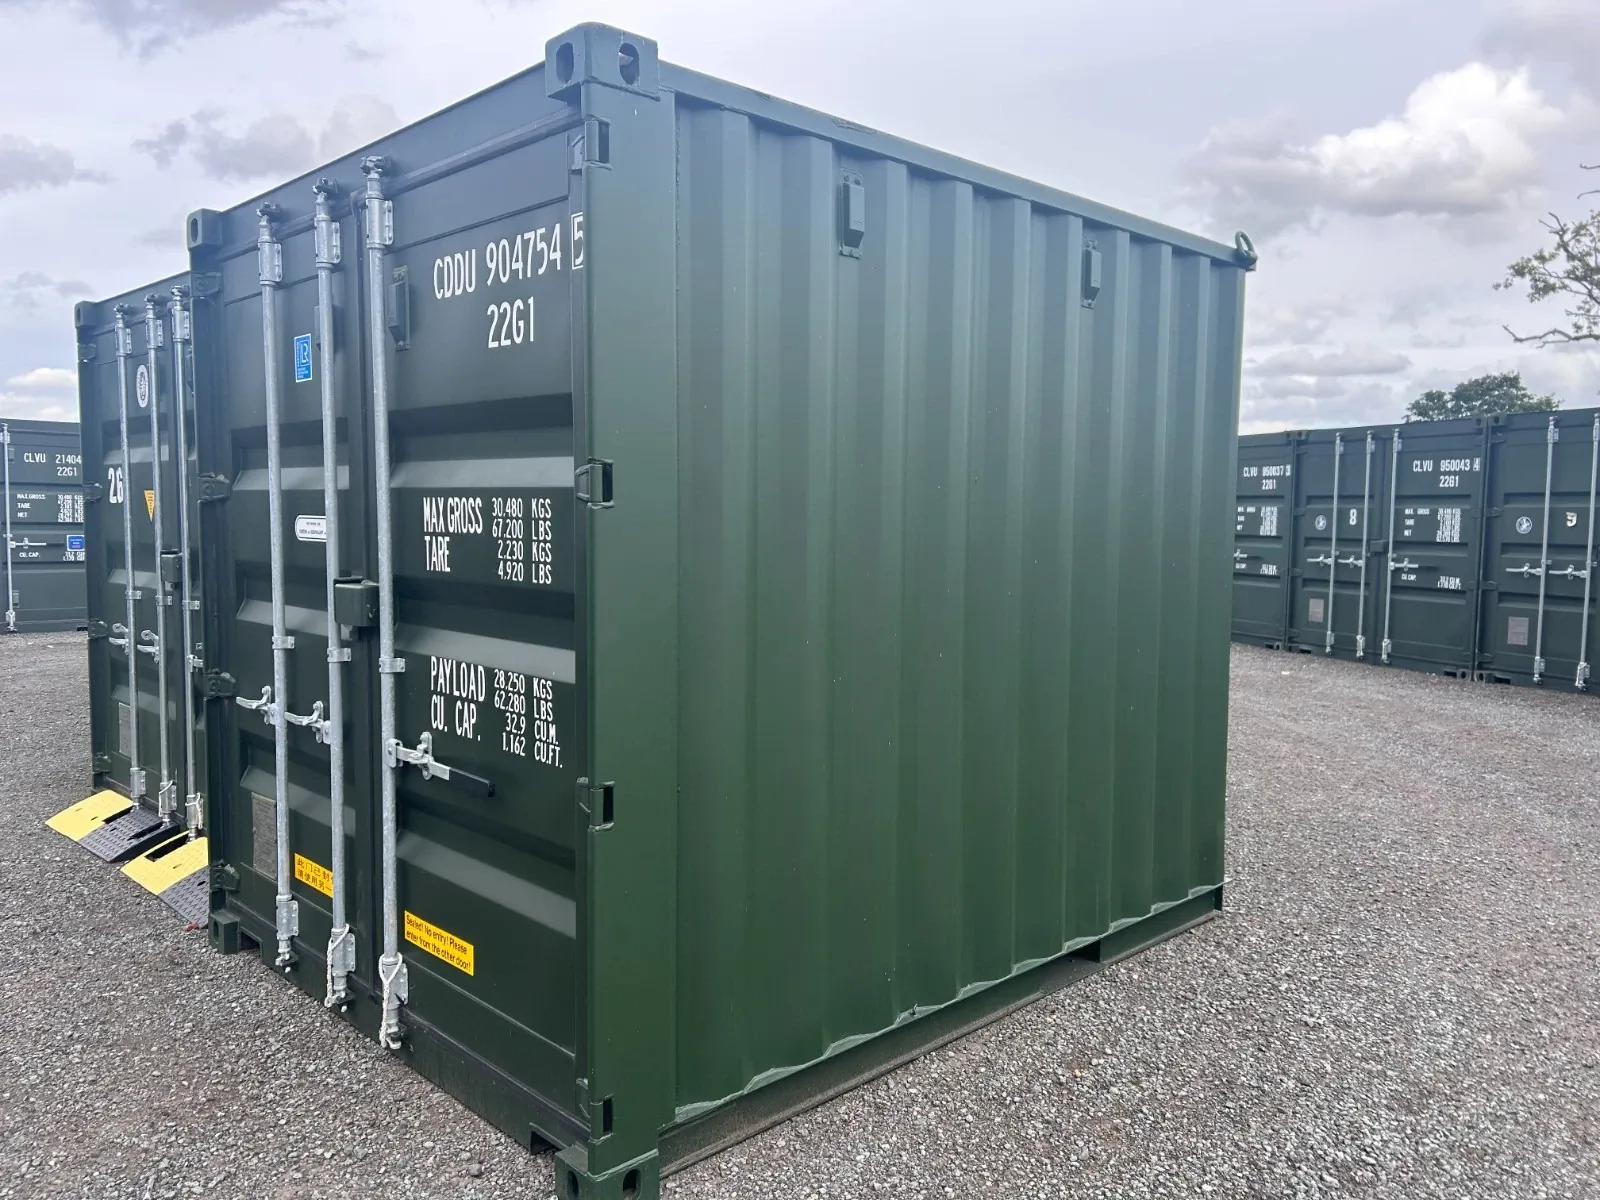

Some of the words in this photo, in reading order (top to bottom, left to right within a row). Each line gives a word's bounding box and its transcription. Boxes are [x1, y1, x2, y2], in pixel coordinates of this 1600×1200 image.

[434, 248, 476, 299] CDDU
[486, 223, 561, 286] 904754
[574, 216, 583, 265] 5
[487, 296, 534, 348] 22G1
[24, 453, 46, 463] CLVU
[56, 454, 82, 464] 21404
[57, 467, 77, 476] 22G1
[1413, 460, 1432, 472] CLVU
[1440, 459, 1470, 472] 950043
[108, 467, 123, 504] 26
[423, 497, 445, 533] MAX
[447, 497, 483, 534] GROSS
[531, 498, 552, 518] KGS
[532, 520, 552, 540] LBS
[1350, 508, 1357, 525] 8
[424, 536, 450, 572] TARE
[532, 542, 552, 562] KGS
[532, 564, 552, 584] LBS
[431, 656, 485, 702] PAYLOAD
[533, 678, 552, 700] KGS
[431, 694, 448, 732] CU.
[455, 700, 481, 741] CAP.
[506, 713, 525, 734] 32.9
[534, 720, 558, 745] CU.M.
[534, 698, 553, 722] LBS
[297, 858, 333, 884] 此门已封
[406, 915, 424, 932] Sealed!
[425, 925, 432, 936] No
[433, 931, 449, 945] entry!
[450, 938, 467, 955] Please
[406, 931, 418, 941] enter
[419, 936, 430, 949] from
[432, 943, 440, 955] the
[441, 949, 455, 961] other
[456, 957, 471, 972] door!
